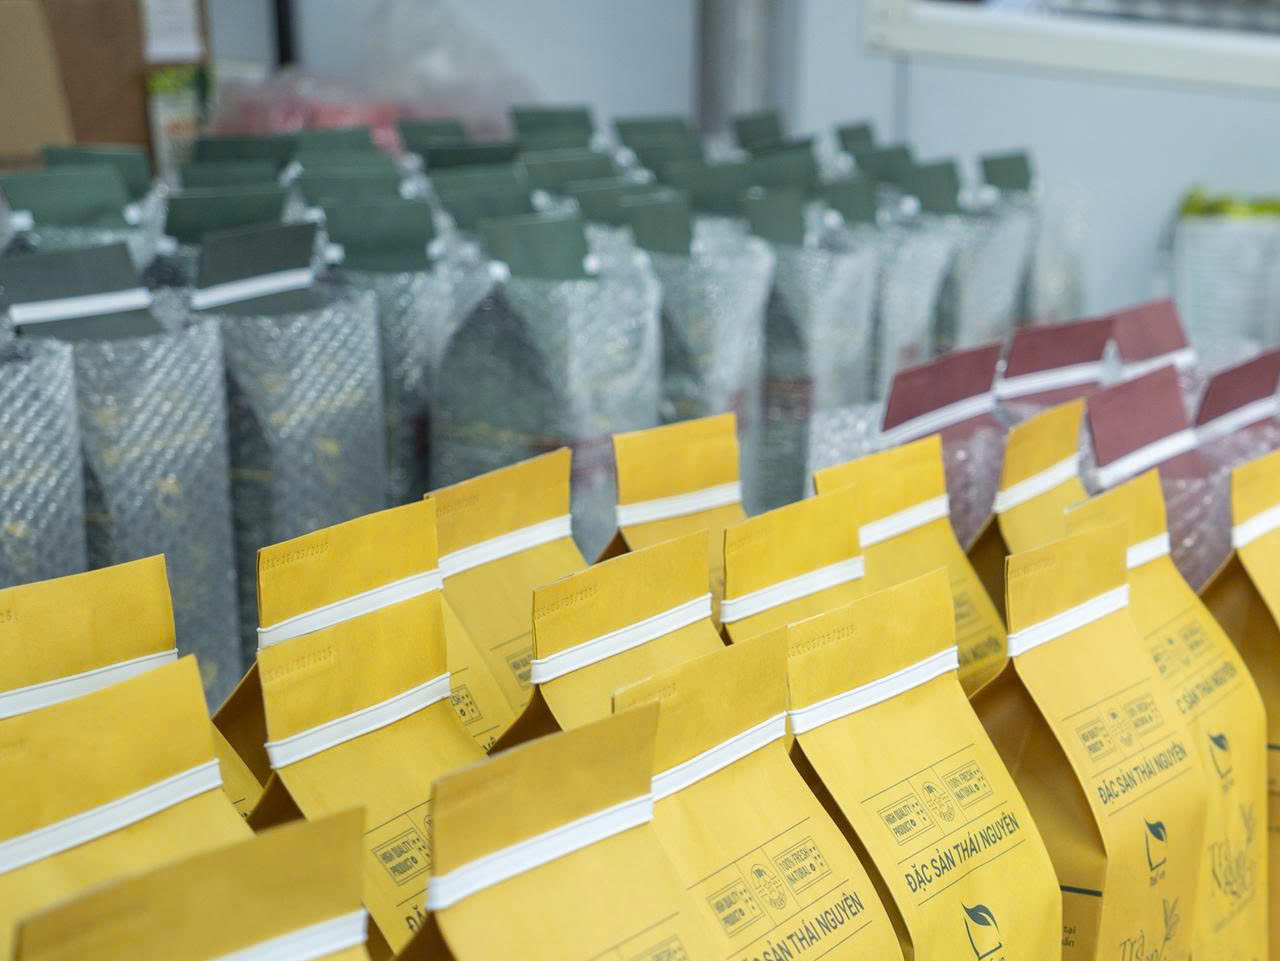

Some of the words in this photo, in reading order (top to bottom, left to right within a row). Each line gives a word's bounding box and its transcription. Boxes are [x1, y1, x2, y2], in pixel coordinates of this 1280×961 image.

[904, 863, 933, 893] ĐẶC
[930, 848, 956, 878] SẢN
[952, 831, 982, 864] THÁI
[979, 811, 1020, 849] NGUYÊN
[786, 919, 822, 954] THÁI
[814, 891, 865, 937] NGUYÊN
